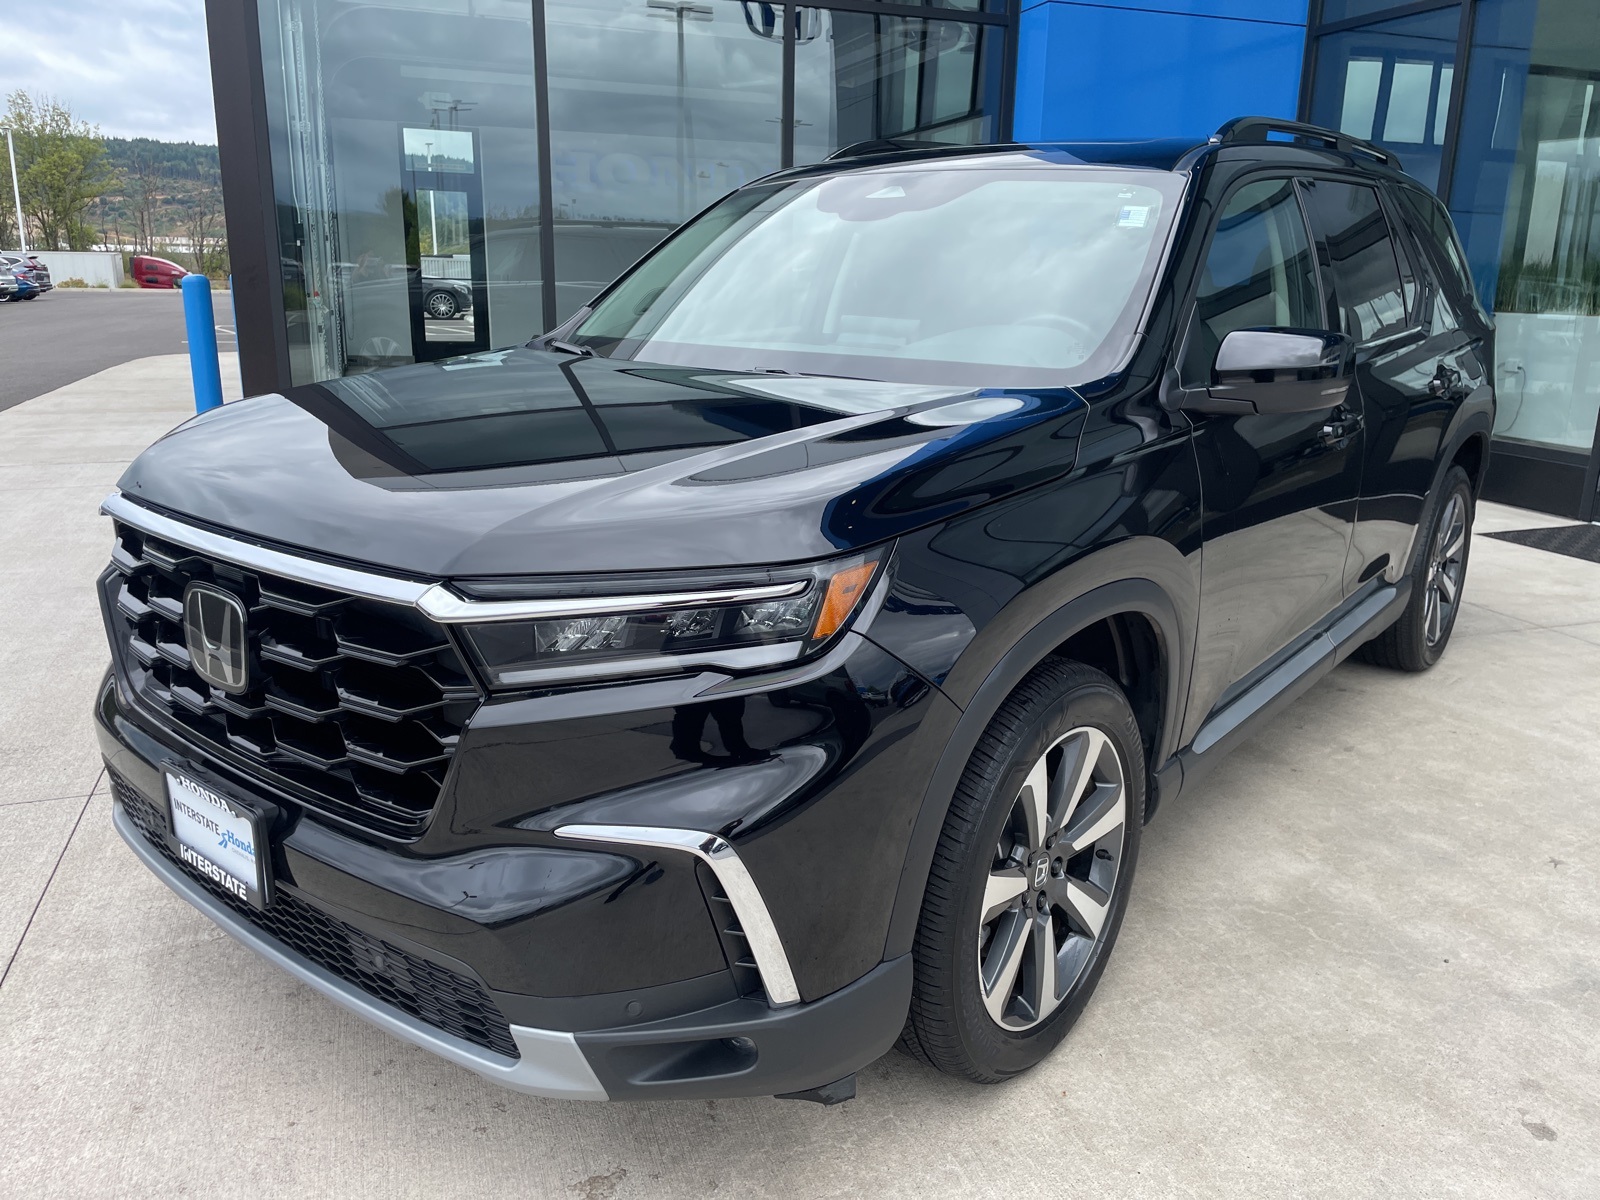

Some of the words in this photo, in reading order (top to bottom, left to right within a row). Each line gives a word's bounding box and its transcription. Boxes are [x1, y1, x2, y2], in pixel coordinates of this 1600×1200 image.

[178, 775, 231, 814] HONDA
[174, 798, 220, 836] INTERSTATE
[180, 843, 248, 901] INTERSTATE
